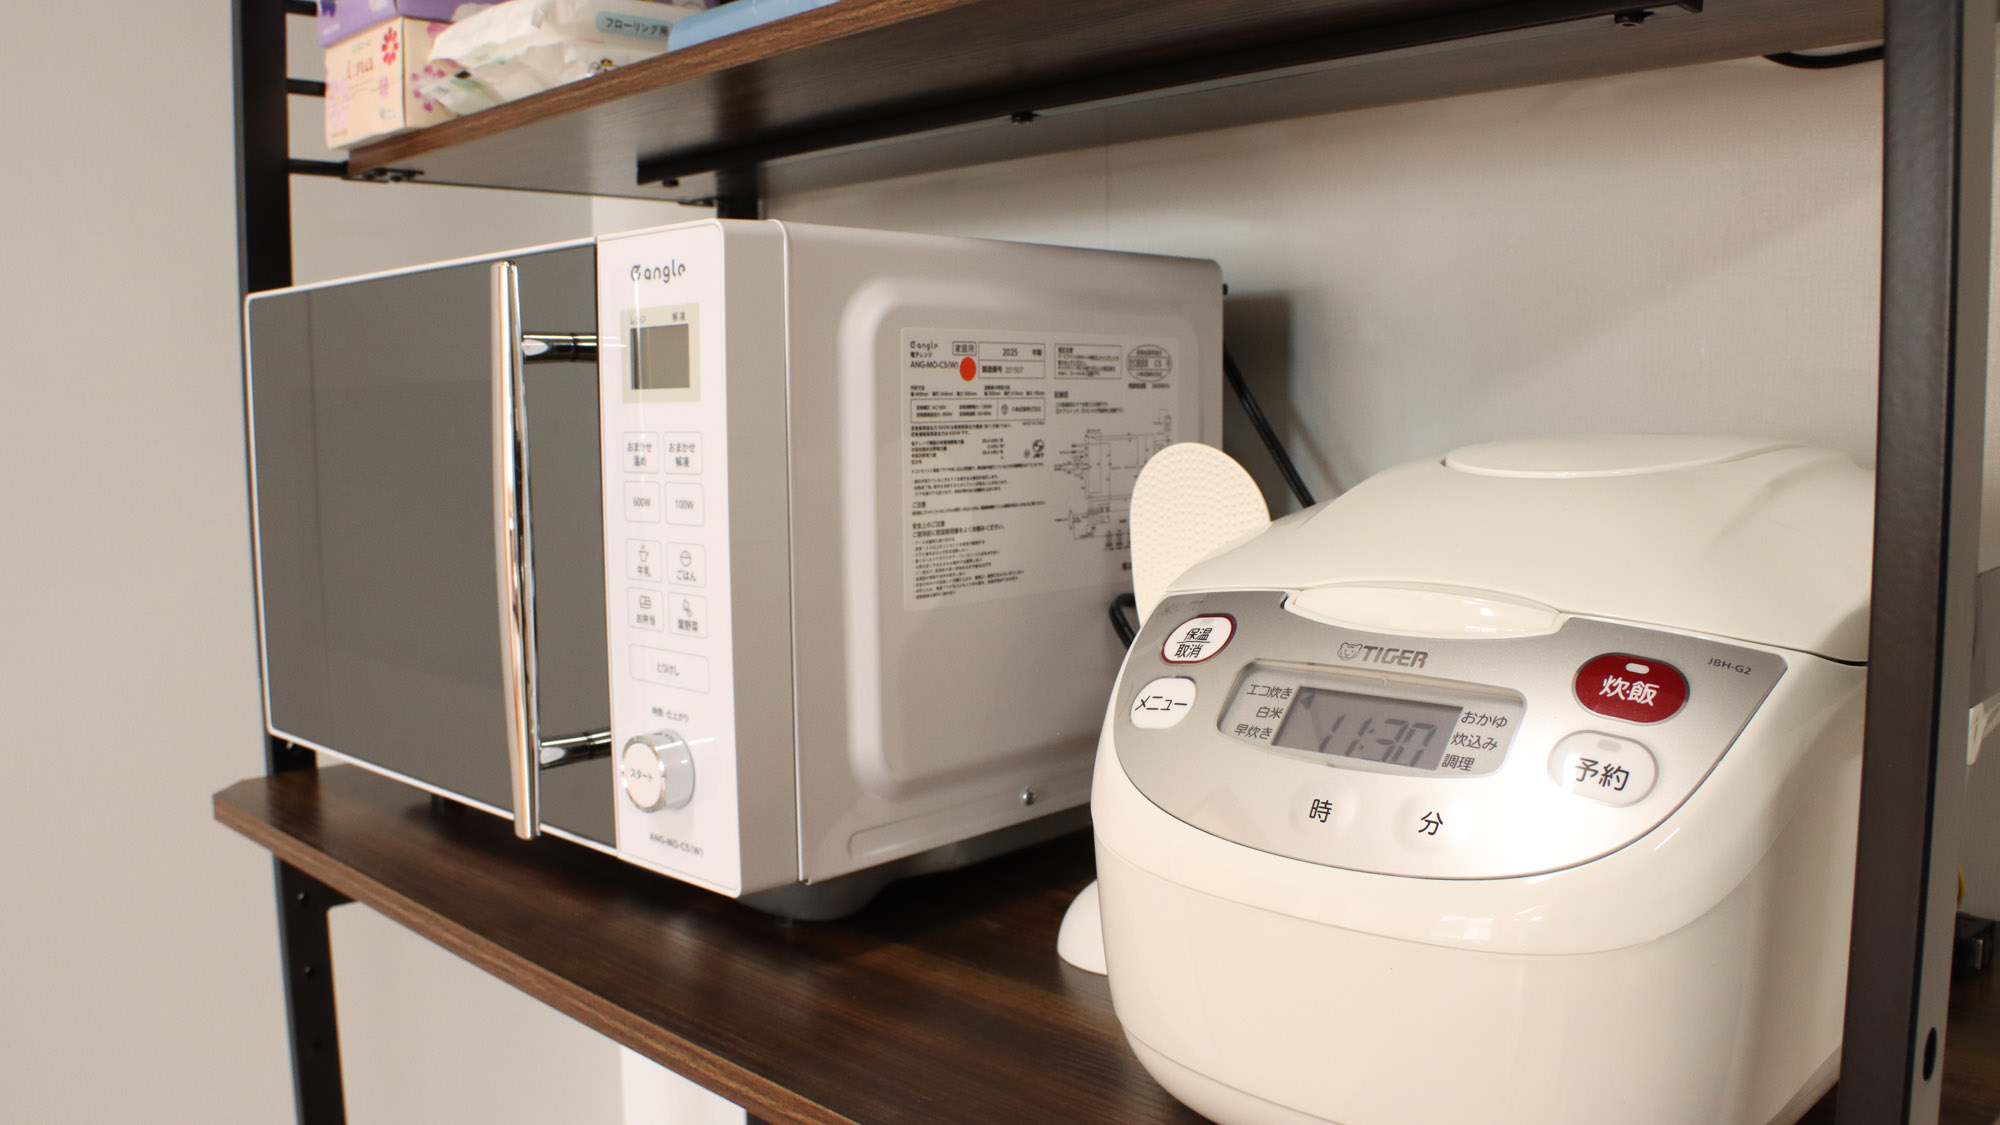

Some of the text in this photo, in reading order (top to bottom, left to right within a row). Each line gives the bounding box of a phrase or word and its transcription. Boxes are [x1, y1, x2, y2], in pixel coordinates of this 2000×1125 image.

[605, 17, 669, 37] フローリング用
[955, 344, 975, 353] 家庭用
[1002, 348, 1018, 357] 2025
[669, 442, 696, 454] おまかせ
[674, 499, 694, 511] 100W
[637, 565, 651, 577] 牛乳
[676, 569, 696, 583] ごはん
[636, 613, 656, 627] お弁当
[1183, 627, 1213, 641] 保温
[1174, 643, 1204, 658] 取消
[1362, 645, 1429, 668] TIGER
[656, 661, 680, 677] とりけし
[1706, 657, 1752, 675] JBH-G2
[1246, 683, 1293, 700] エコ炊き
[1598, 674, 1660, 706] 炊飯
[1134, 695, 1188, 711] メニュー
[1255, 705, 1283, 720] 白米
[1460, 710, 1508, 729] おかゆ
[1234, 723, 1273, 741] 早炊き
[1318, 713, 1439, 767] 11:30
[1450, 732, 1498, 751] 炊込み
[1442, 753, 1475, 772] 調理
[629, 767, 654, 782] スタート
[1575, 757, 1630, 791] 予約
[1308, 798, 1333, 823] 時
[1418, 811, 1444, 836] 分
